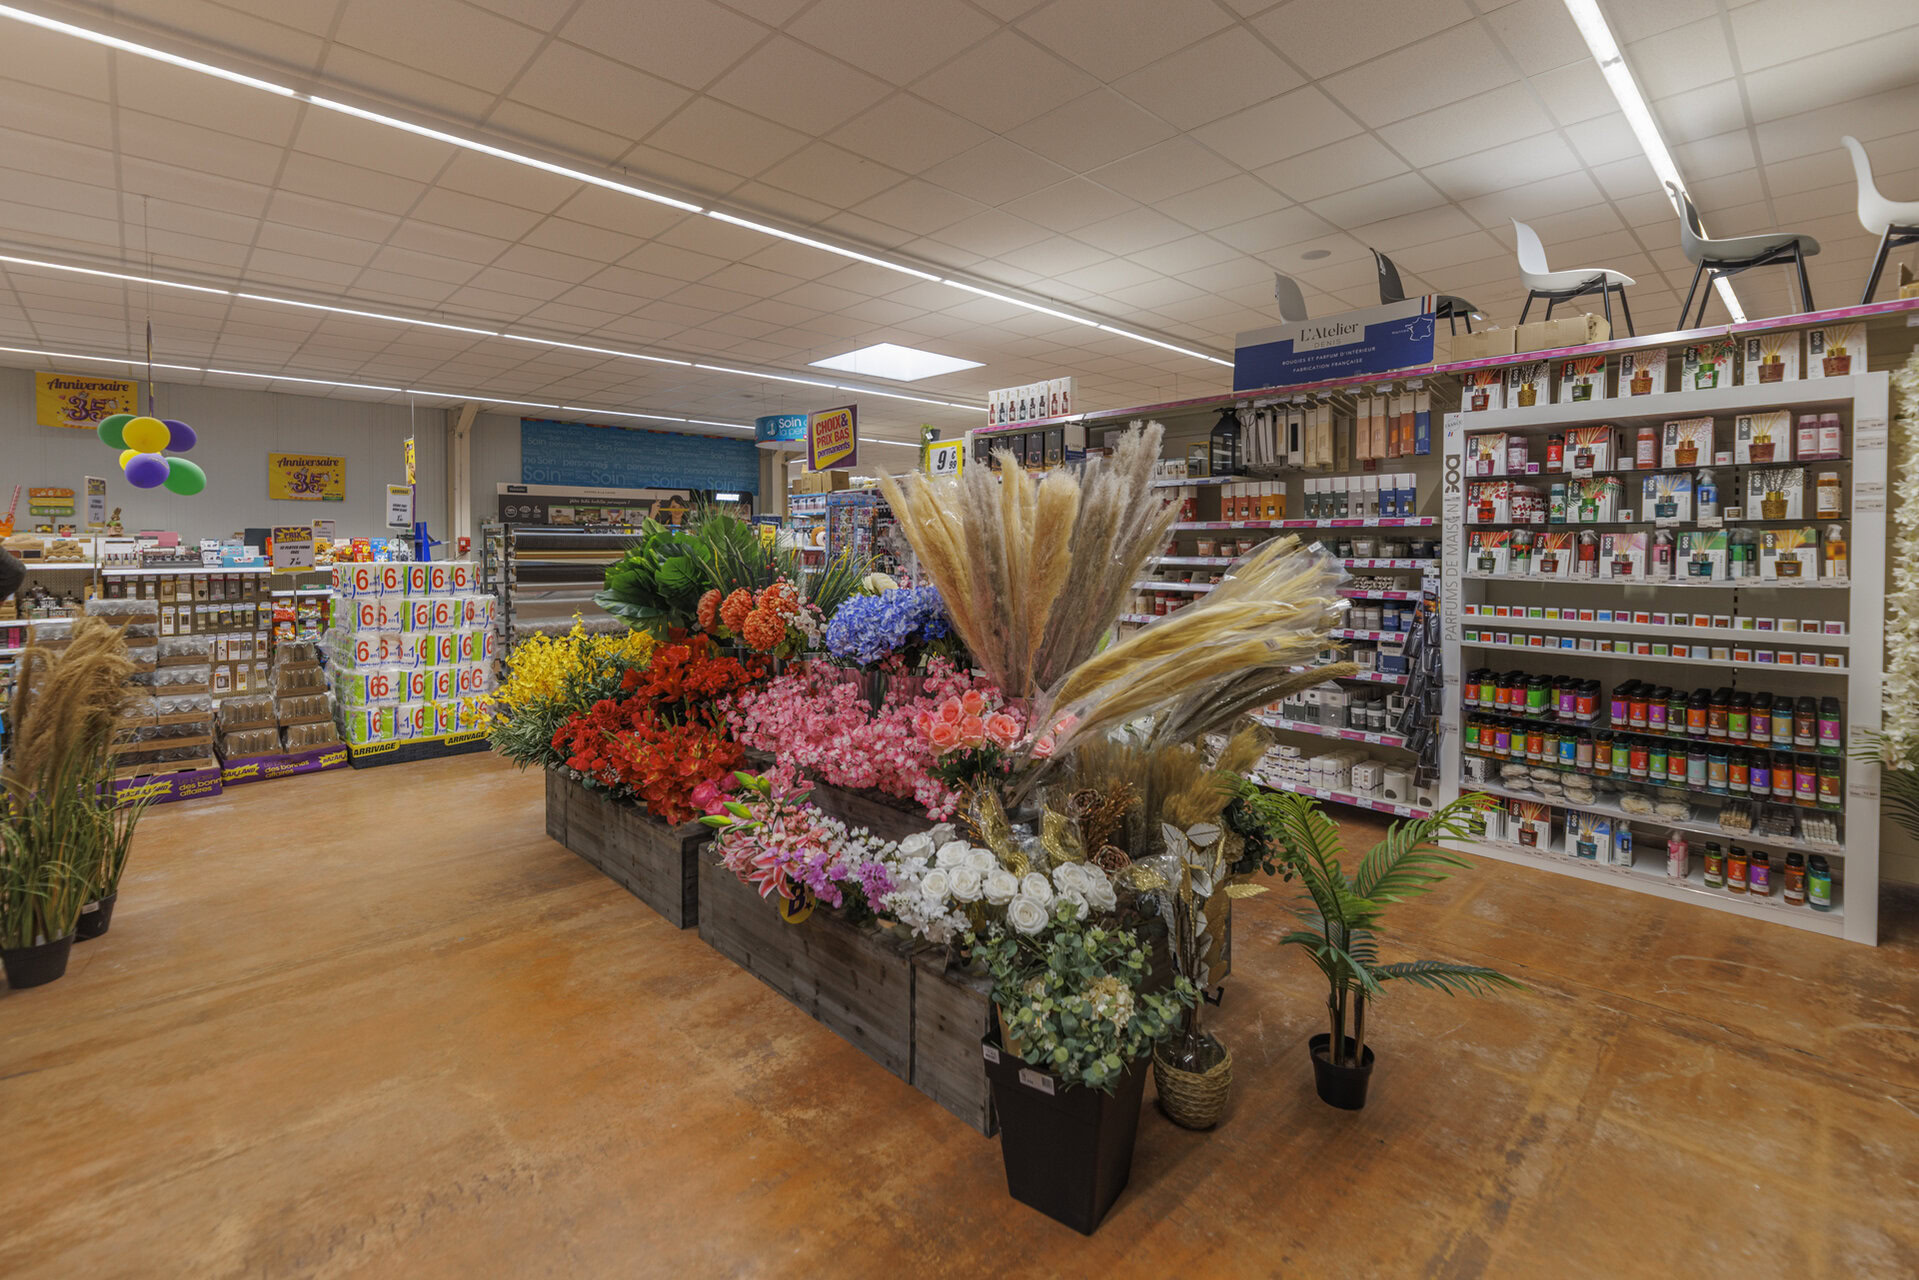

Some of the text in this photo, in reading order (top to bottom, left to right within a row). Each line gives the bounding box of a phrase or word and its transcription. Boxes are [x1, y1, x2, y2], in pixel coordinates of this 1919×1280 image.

[1300, 322, 1359, 342] L'Atelier
[1314, 338, 1342, 349] DENIS
[1316, 352, 1339, 361] PARFUM
[1293, 362, 1330, 373] FABRICATION
[47, 378, 129, 392] Anniversaire
[68, 396, 106, 422] 35
[778, 416, 802, 428] Soin
[816, 416, 841, 436] CHOIX
[780, 427, 808, 438] la pers
[816, 427, 850, 449] PRIX BAS
[817, 441, 851, 459] permanents
[937, 450, 947, 470] 9
[277, 457, 340, 468] Anniversaire
[293, 472, 323, 494] 35
[523, 465, 561, 482] Soin
[591, 469, 625, 486] Soin
[652, 473, 683, 488] Soin
[384, 567, 397, 589] 6
[454, 567, 466, 587] 6
[1445, 560, 1459, 576] DE
[356, 569, 369, 591] 6
[412, 568, 424, 589] 6
[432, 568, 445, 589] 6
[361, 604, 374, 626] 6
[416, 604, 428, 625] 6
[435, 603, 448, 624] 6
[1445, 581, 1459, 642] PARFUMS
[357, 641, 369, 662] 6
[463, 636, 472, 656] 6
[378, 675, 389, 696] 6
[412, 673, 424, 694] 6
[439, 672, 449, 693] 6
[460, 670, 470, 690] 6
[471, 668, 483, 688] 6
[448, 730, 487, 744] ARRIVAGE
[353, 742, 397, 757] ARRIVAGE
[265, 768, 294, 778] affaires
[281, 760, 310, 769] bonnes
[179, 777, 221, 792] des bonn
[180, 785, 213, 797] affaires
